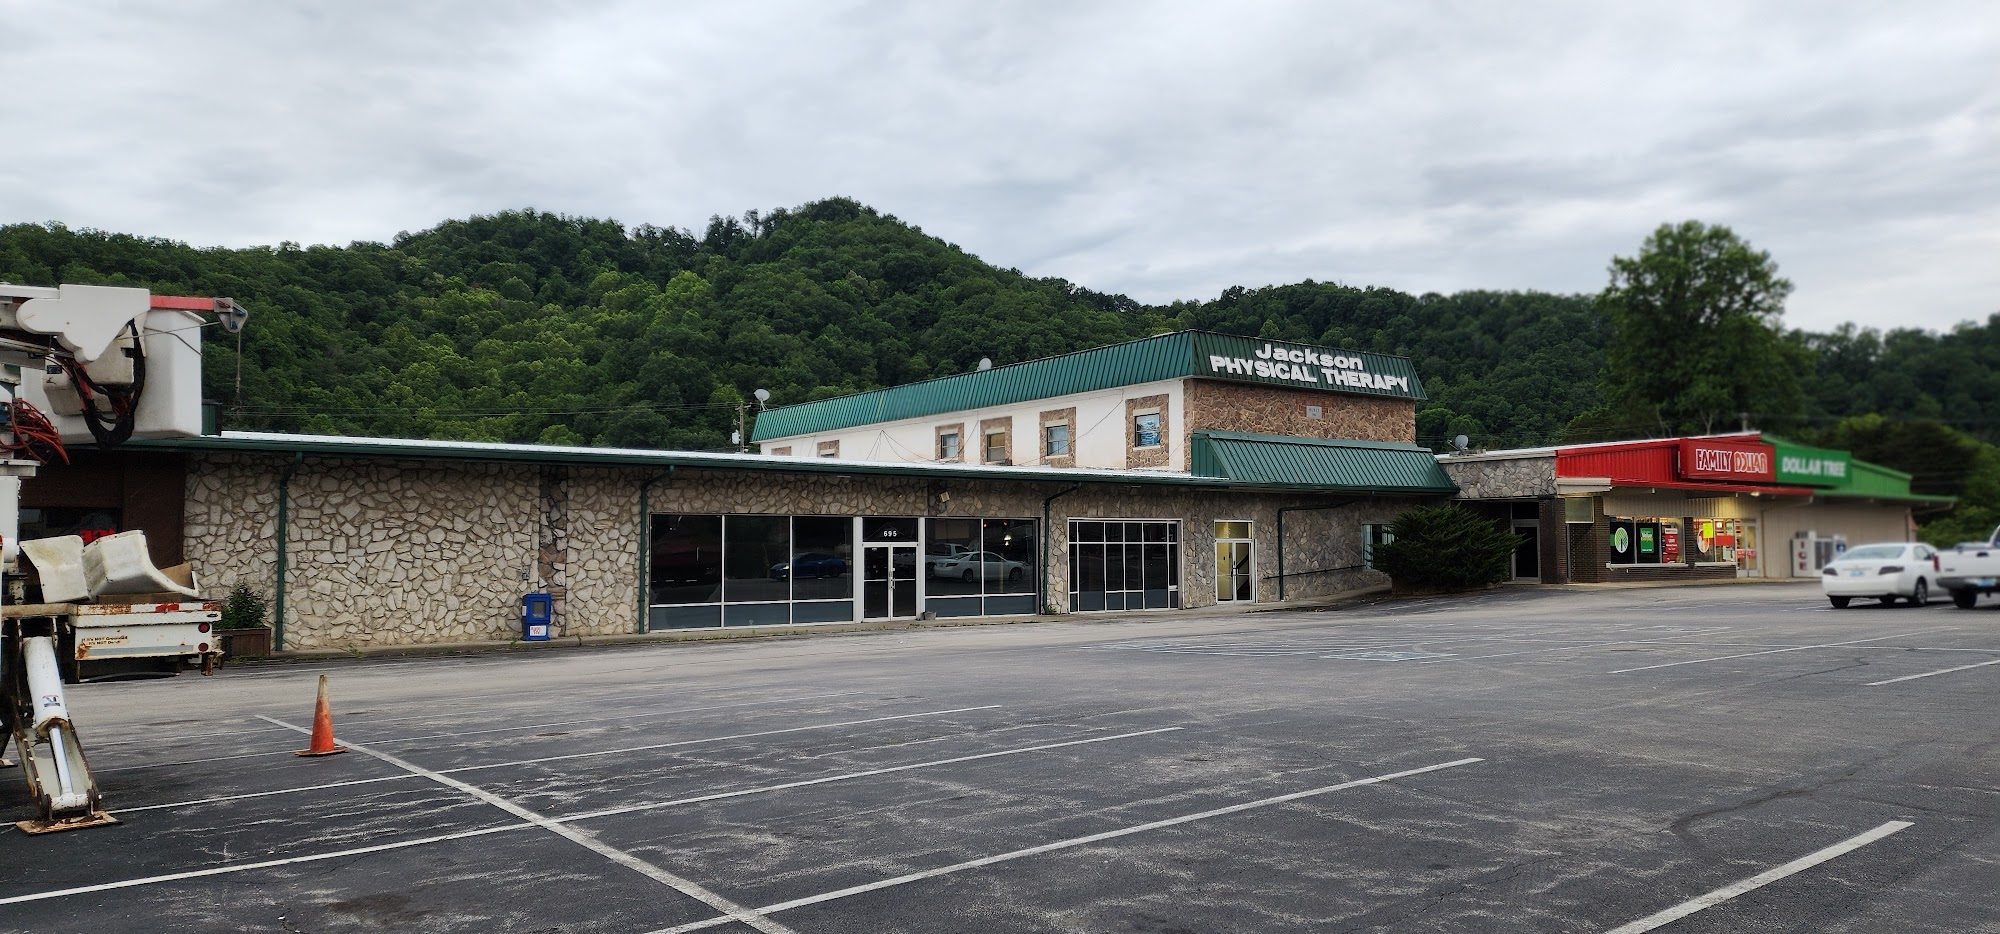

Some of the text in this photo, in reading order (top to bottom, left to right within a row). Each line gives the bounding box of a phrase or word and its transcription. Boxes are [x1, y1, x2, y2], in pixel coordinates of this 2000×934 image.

[1255, 344, 1363, 371] Jackson
[1209, 355, 1409, 393] PHYSICAL THERAPY
[1696, 449, 1768, 474] FAMILY DOLLAR
[1782, 456, 1846, 477] DOLLAR TREE
